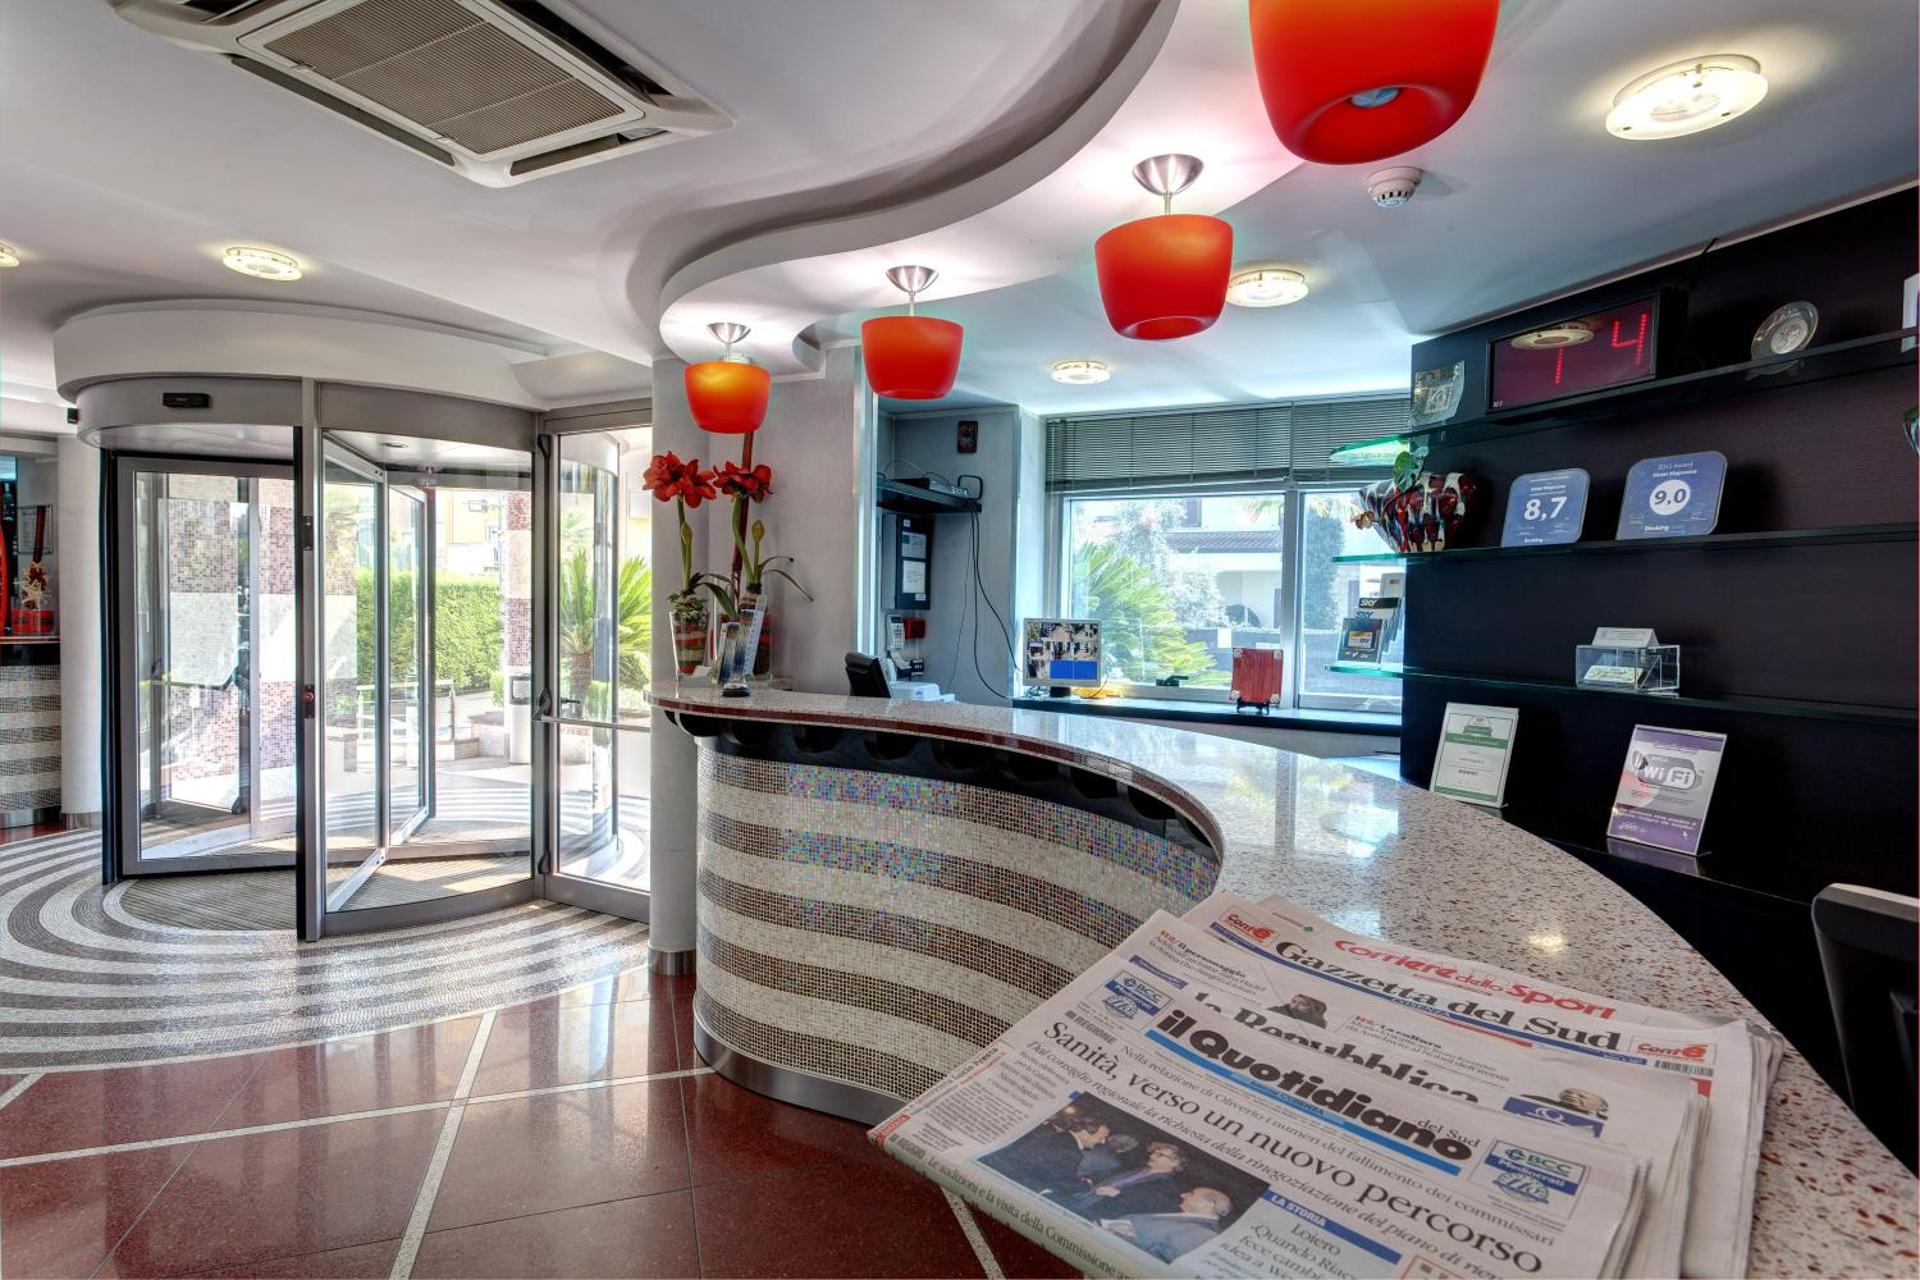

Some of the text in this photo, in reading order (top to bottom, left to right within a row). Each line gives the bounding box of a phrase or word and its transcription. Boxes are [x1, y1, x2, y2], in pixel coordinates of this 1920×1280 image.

[1524, 496, 1568, 521] 8,7
[1275, 941, 1438, 1006] Gazzetta
[1447, 1000, 1516, 1026] del
[1523, 1016, 1622, 1050] Sud
[1334, 940, 1458, 979] Corriere
[1455, 975, 1503, 991] dello
[1505, 983, 1617, 1019] Sport
[1074, 1015, 1117, 1045] REGIONE
[1044, 1021, 1119, 1081] Sanità,
[1128, 1073, 1200, 1115] verso
[1203, 1110, 1244, 1137] un
[1245, 1131, 1356, 1187] nuovo
[1355, 1182, 1542, 1273] percorso
[1124, 1046, 1149, 1065] Nella
[1149, 1061, 1200, 1091] relazione
[1201, 1087, 1212, 1099] di
[1214, 1094, 1265, 1121] Oliverio
[1272, 1119, 1320, 1145] numeri
[1322, 1139, 1346, 1155] del
[1348, 1148, 1423, 1190] fallimento
[1425, 1183, 1452, 1203] dei
[1454, 1198, 1555, 1247] commissari
[1416, 1117, 1481, 1148] del Sud
[1026, 1040, 1049, 1056] Dal
[1047, 1054, 1093, 1085] consiglio
[1091, 1081, 1146, 1112] regionale
[1144, 1106, 1158, 1118] la
[1158, 1114, 1210, 1144] richiesta
[1211, 1139, 1246, 1161] della
[1246, 1156, 1359, 1216] rinegoziazione
[1358, 1207, 1387, 1230] del
[1382, 1223, 1438, 1253] piano
[1439, 1249, 1464, 1266] di
[1527, 1154, 1573, 1174] BCC
[1271, 1194, 1326, 1227] LA STORIA
[996, 1197, 1020, 1219] visita
[1020, 1210, 1045, 1234] della
[1047, 1226, 1116, 1273] Commissione
[1219, 1240, 1252, 1261] idea
[1291, 1223, 1341, 1256] Loiero
